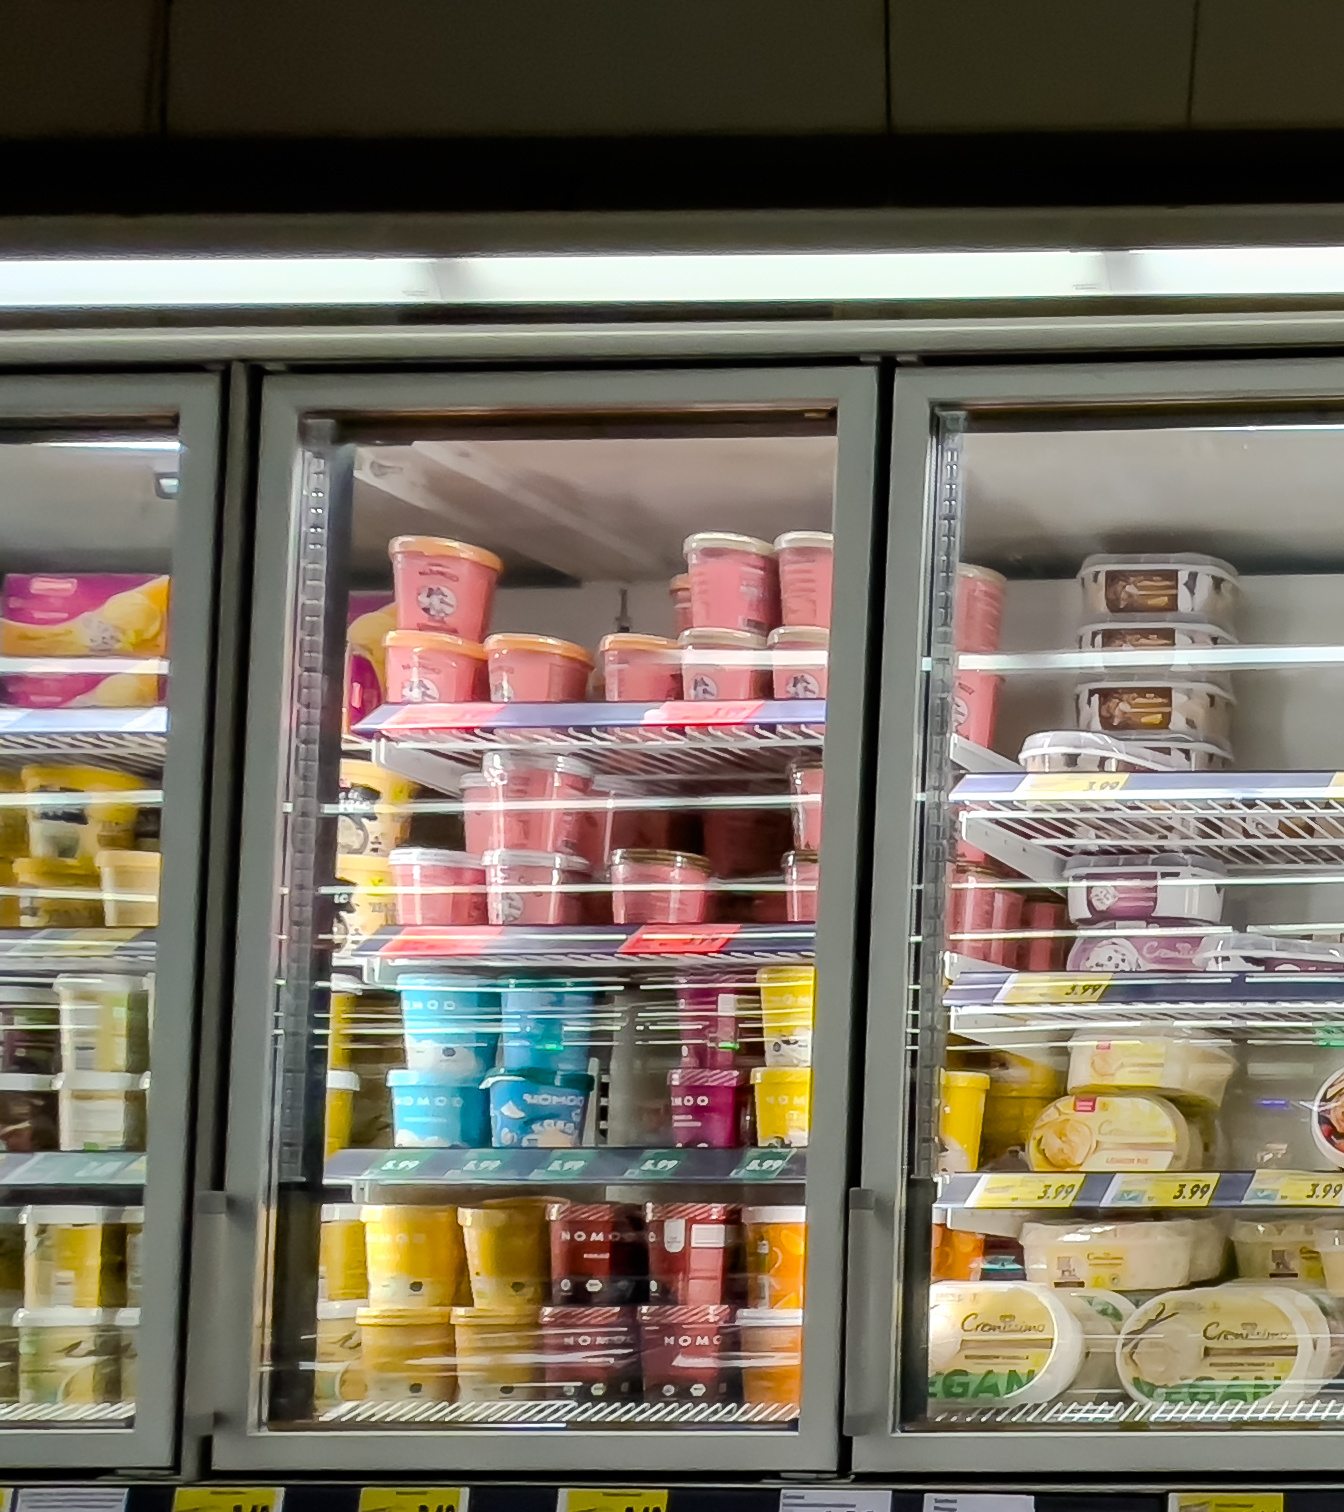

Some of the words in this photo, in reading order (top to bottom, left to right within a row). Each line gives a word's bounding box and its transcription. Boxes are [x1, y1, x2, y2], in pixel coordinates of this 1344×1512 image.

[1037, 1183, 1076, 1200] 3.99
[1174, 1183, 1211, 1200] 3.99
[1306, 1182, 1344, 1199] 3.99
[929, 1368, 1035, 1399] EGAN
